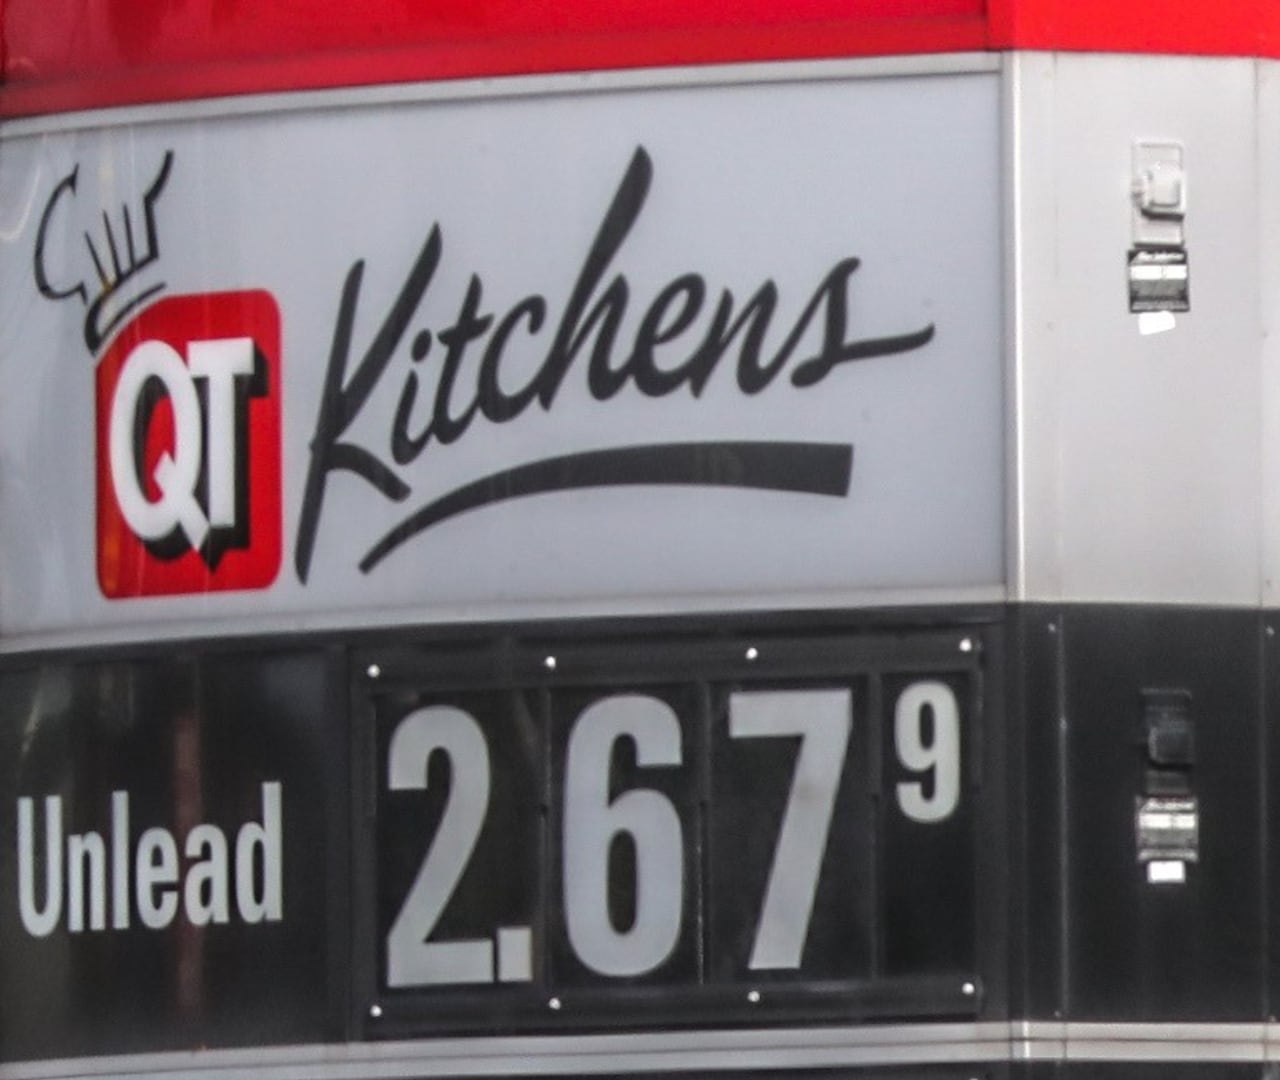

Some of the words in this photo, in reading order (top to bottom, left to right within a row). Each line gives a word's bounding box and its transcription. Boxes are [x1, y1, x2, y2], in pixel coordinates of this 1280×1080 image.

[109, 338, 257, 553] QT
[293, 145, 935, 585] Kitchens
[16, 781, 283, 937] Unlead
